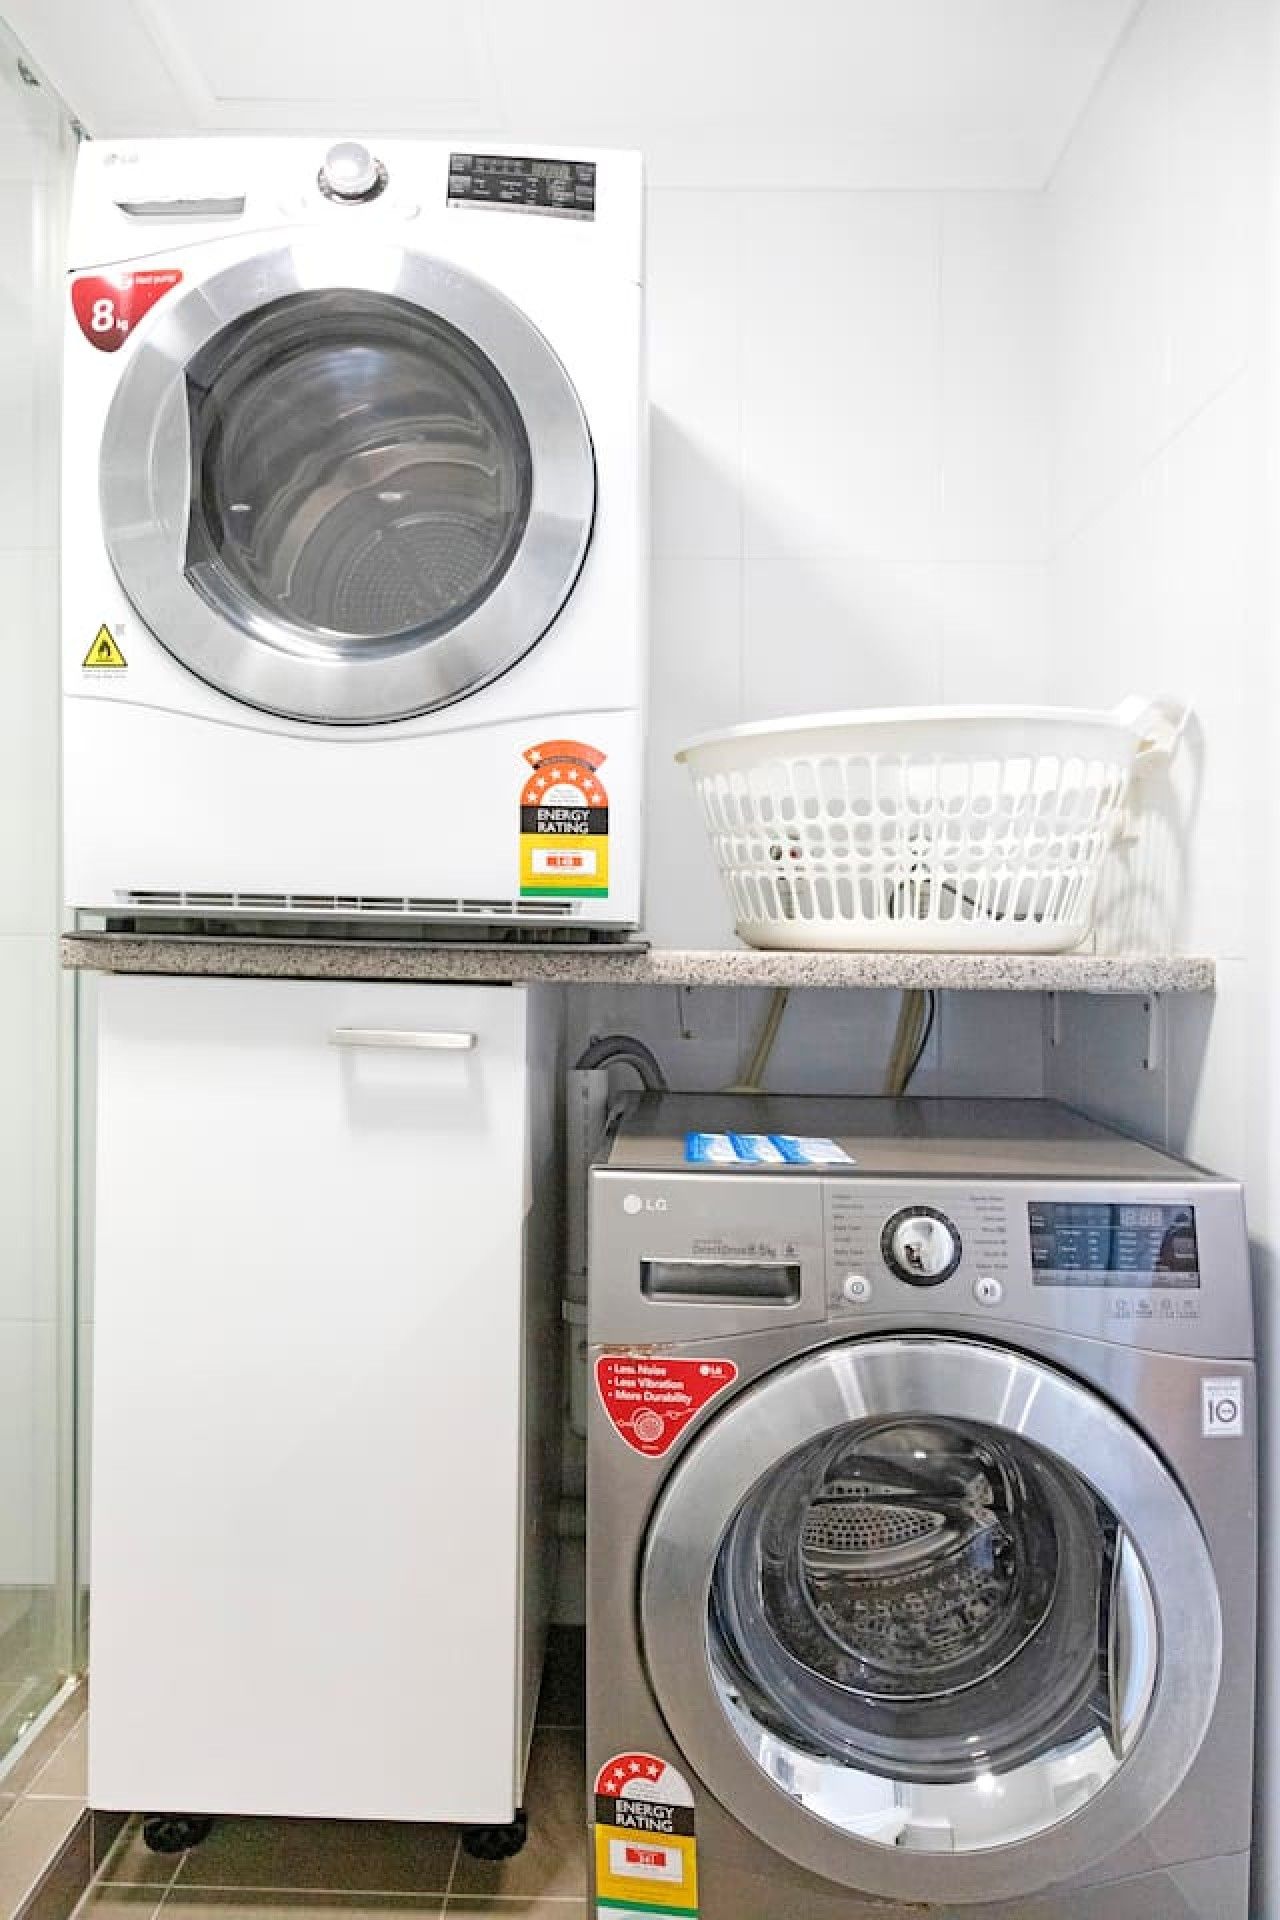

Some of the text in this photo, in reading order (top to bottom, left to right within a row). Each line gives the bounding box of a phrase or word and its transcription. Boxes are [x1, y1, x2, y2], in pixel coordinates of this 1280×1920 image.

[91, 298, 115, 333] 8
[537, 807, 591, 821] ENERGY
[537, 821, 589, 834] RATING
[645, 1199, 668, 1211] LG
[613, 1363, 667, 1376] Less Noise
[613, 1376, 685, 1390] Less Vibration
[614, 1389, 693, 1406] More Durability
[615, 1799, 675, 1820] ENERGY
[615, 1813, 673, 1833] RATING
